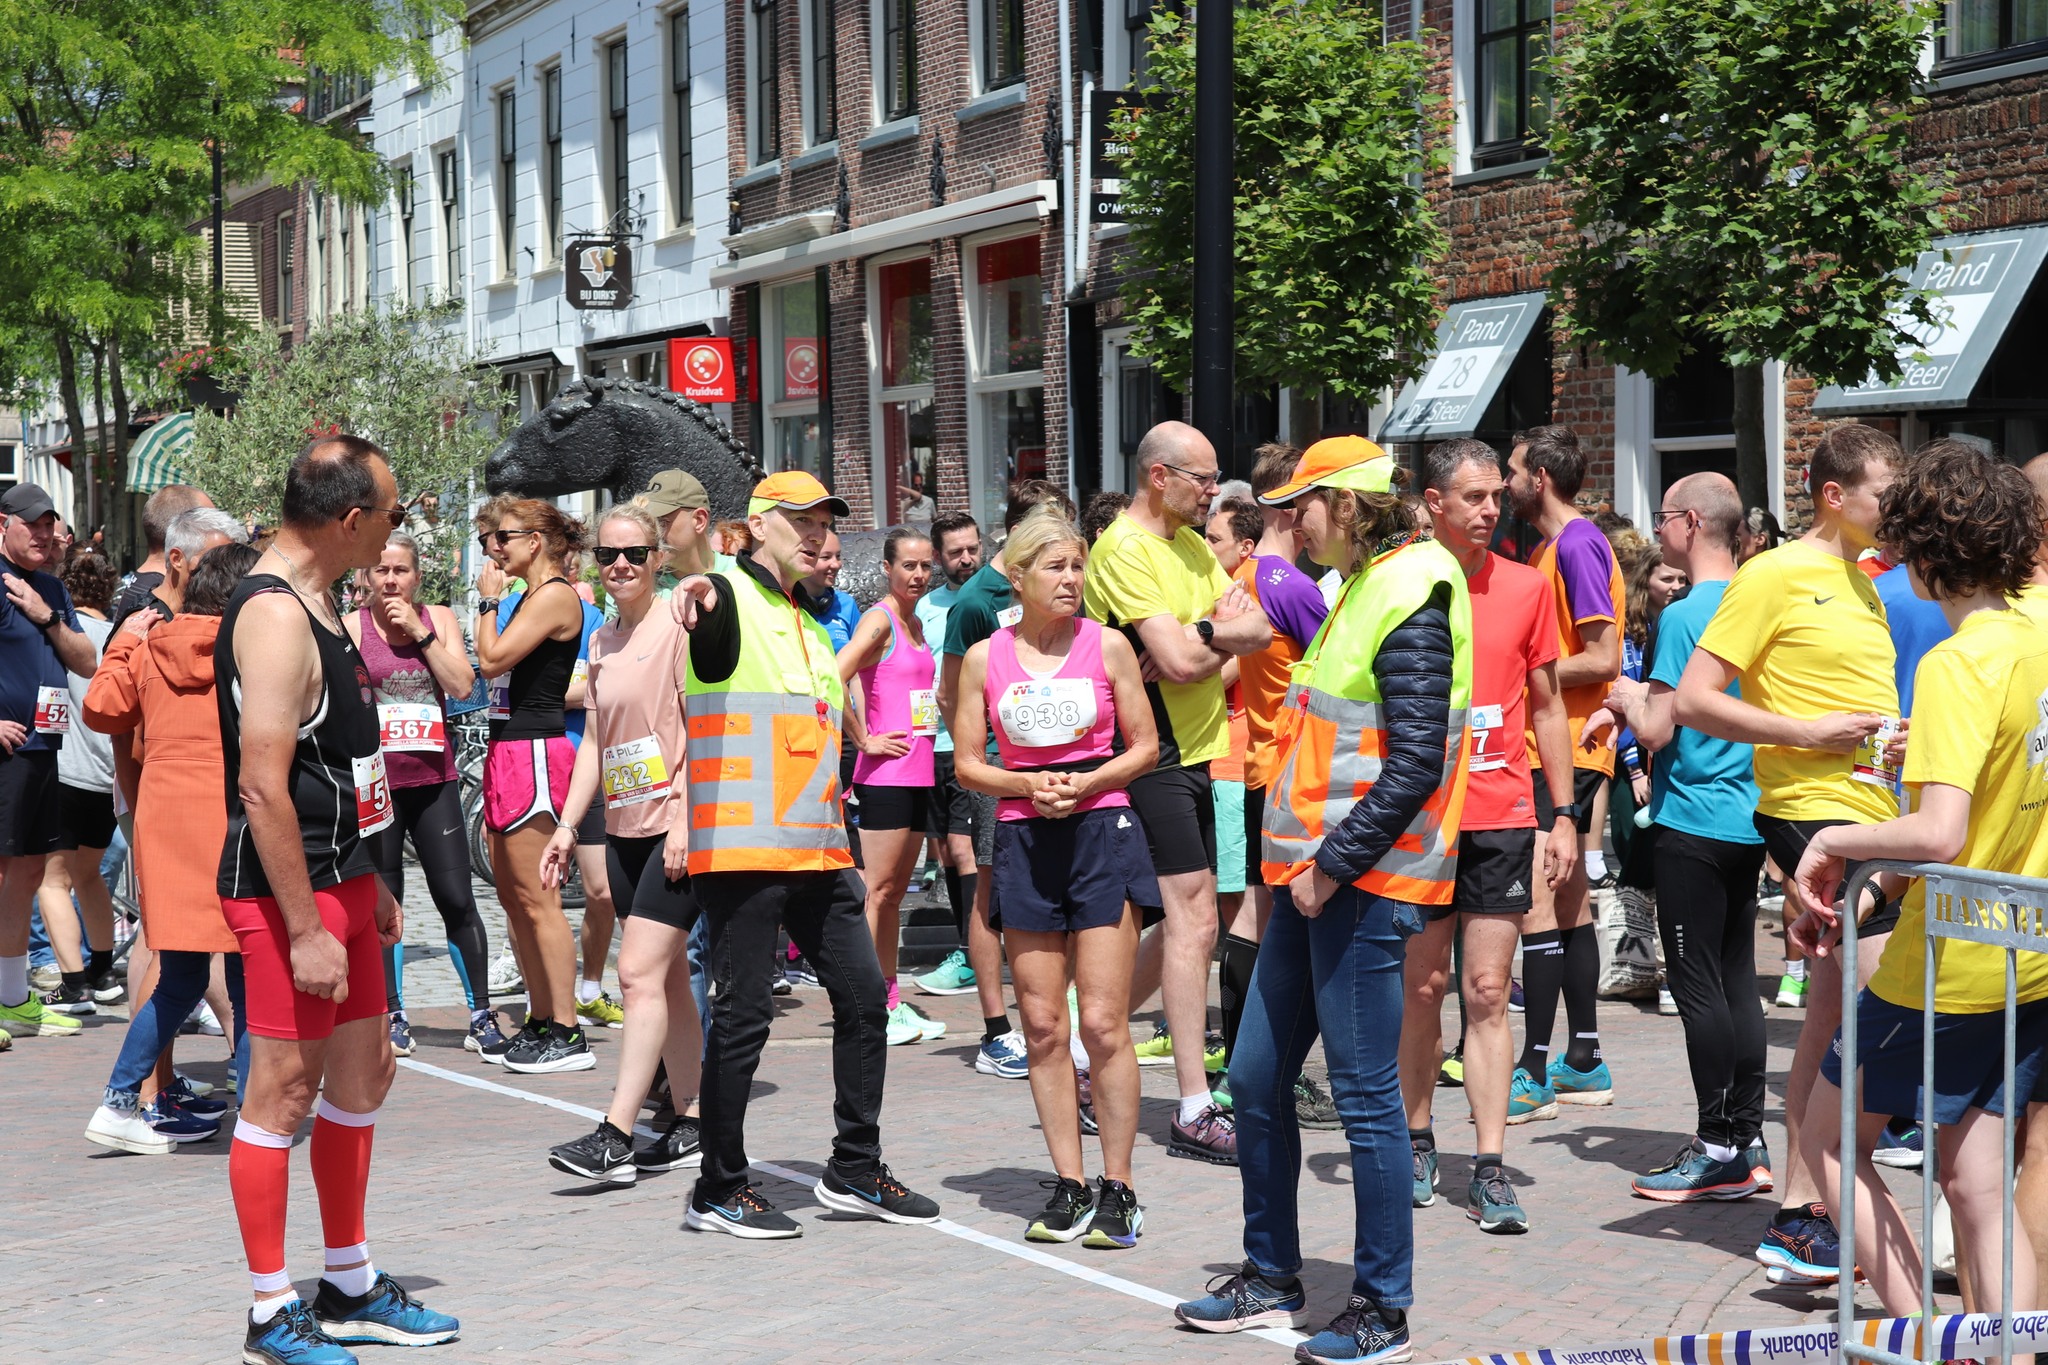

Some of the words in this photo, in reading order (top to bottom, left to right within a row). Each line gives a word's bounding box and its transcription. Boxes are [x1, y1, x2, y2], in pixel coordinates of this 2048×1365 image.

[1922, 252, 1996, 291] Pand
[1458, 313, 1510, 344] Pand
[1437, 354, 1478, 391] 28
[685, 386, 724, 397] Kruidvat
[1405, 403, 1426, 423] De
[1427, 400, 1468, 422] Sfeer
[388, 720, 433, 739] 567
[1015, 700, 1081, 732] 938
[616, 743, 643, 759] PILZ
[1472, 729, 1490, 755] 7
[609, 761, 653, 792] 282
[1506, 889, 1526, 898] adidas
[1934, 892, 2048, 938] HANSWI
[1969, 1315, 2048, 1346] aboank
[1562, 1348, 1648, 1365] Rabobank
[1760, 1331, 1839, 1361] abobank
